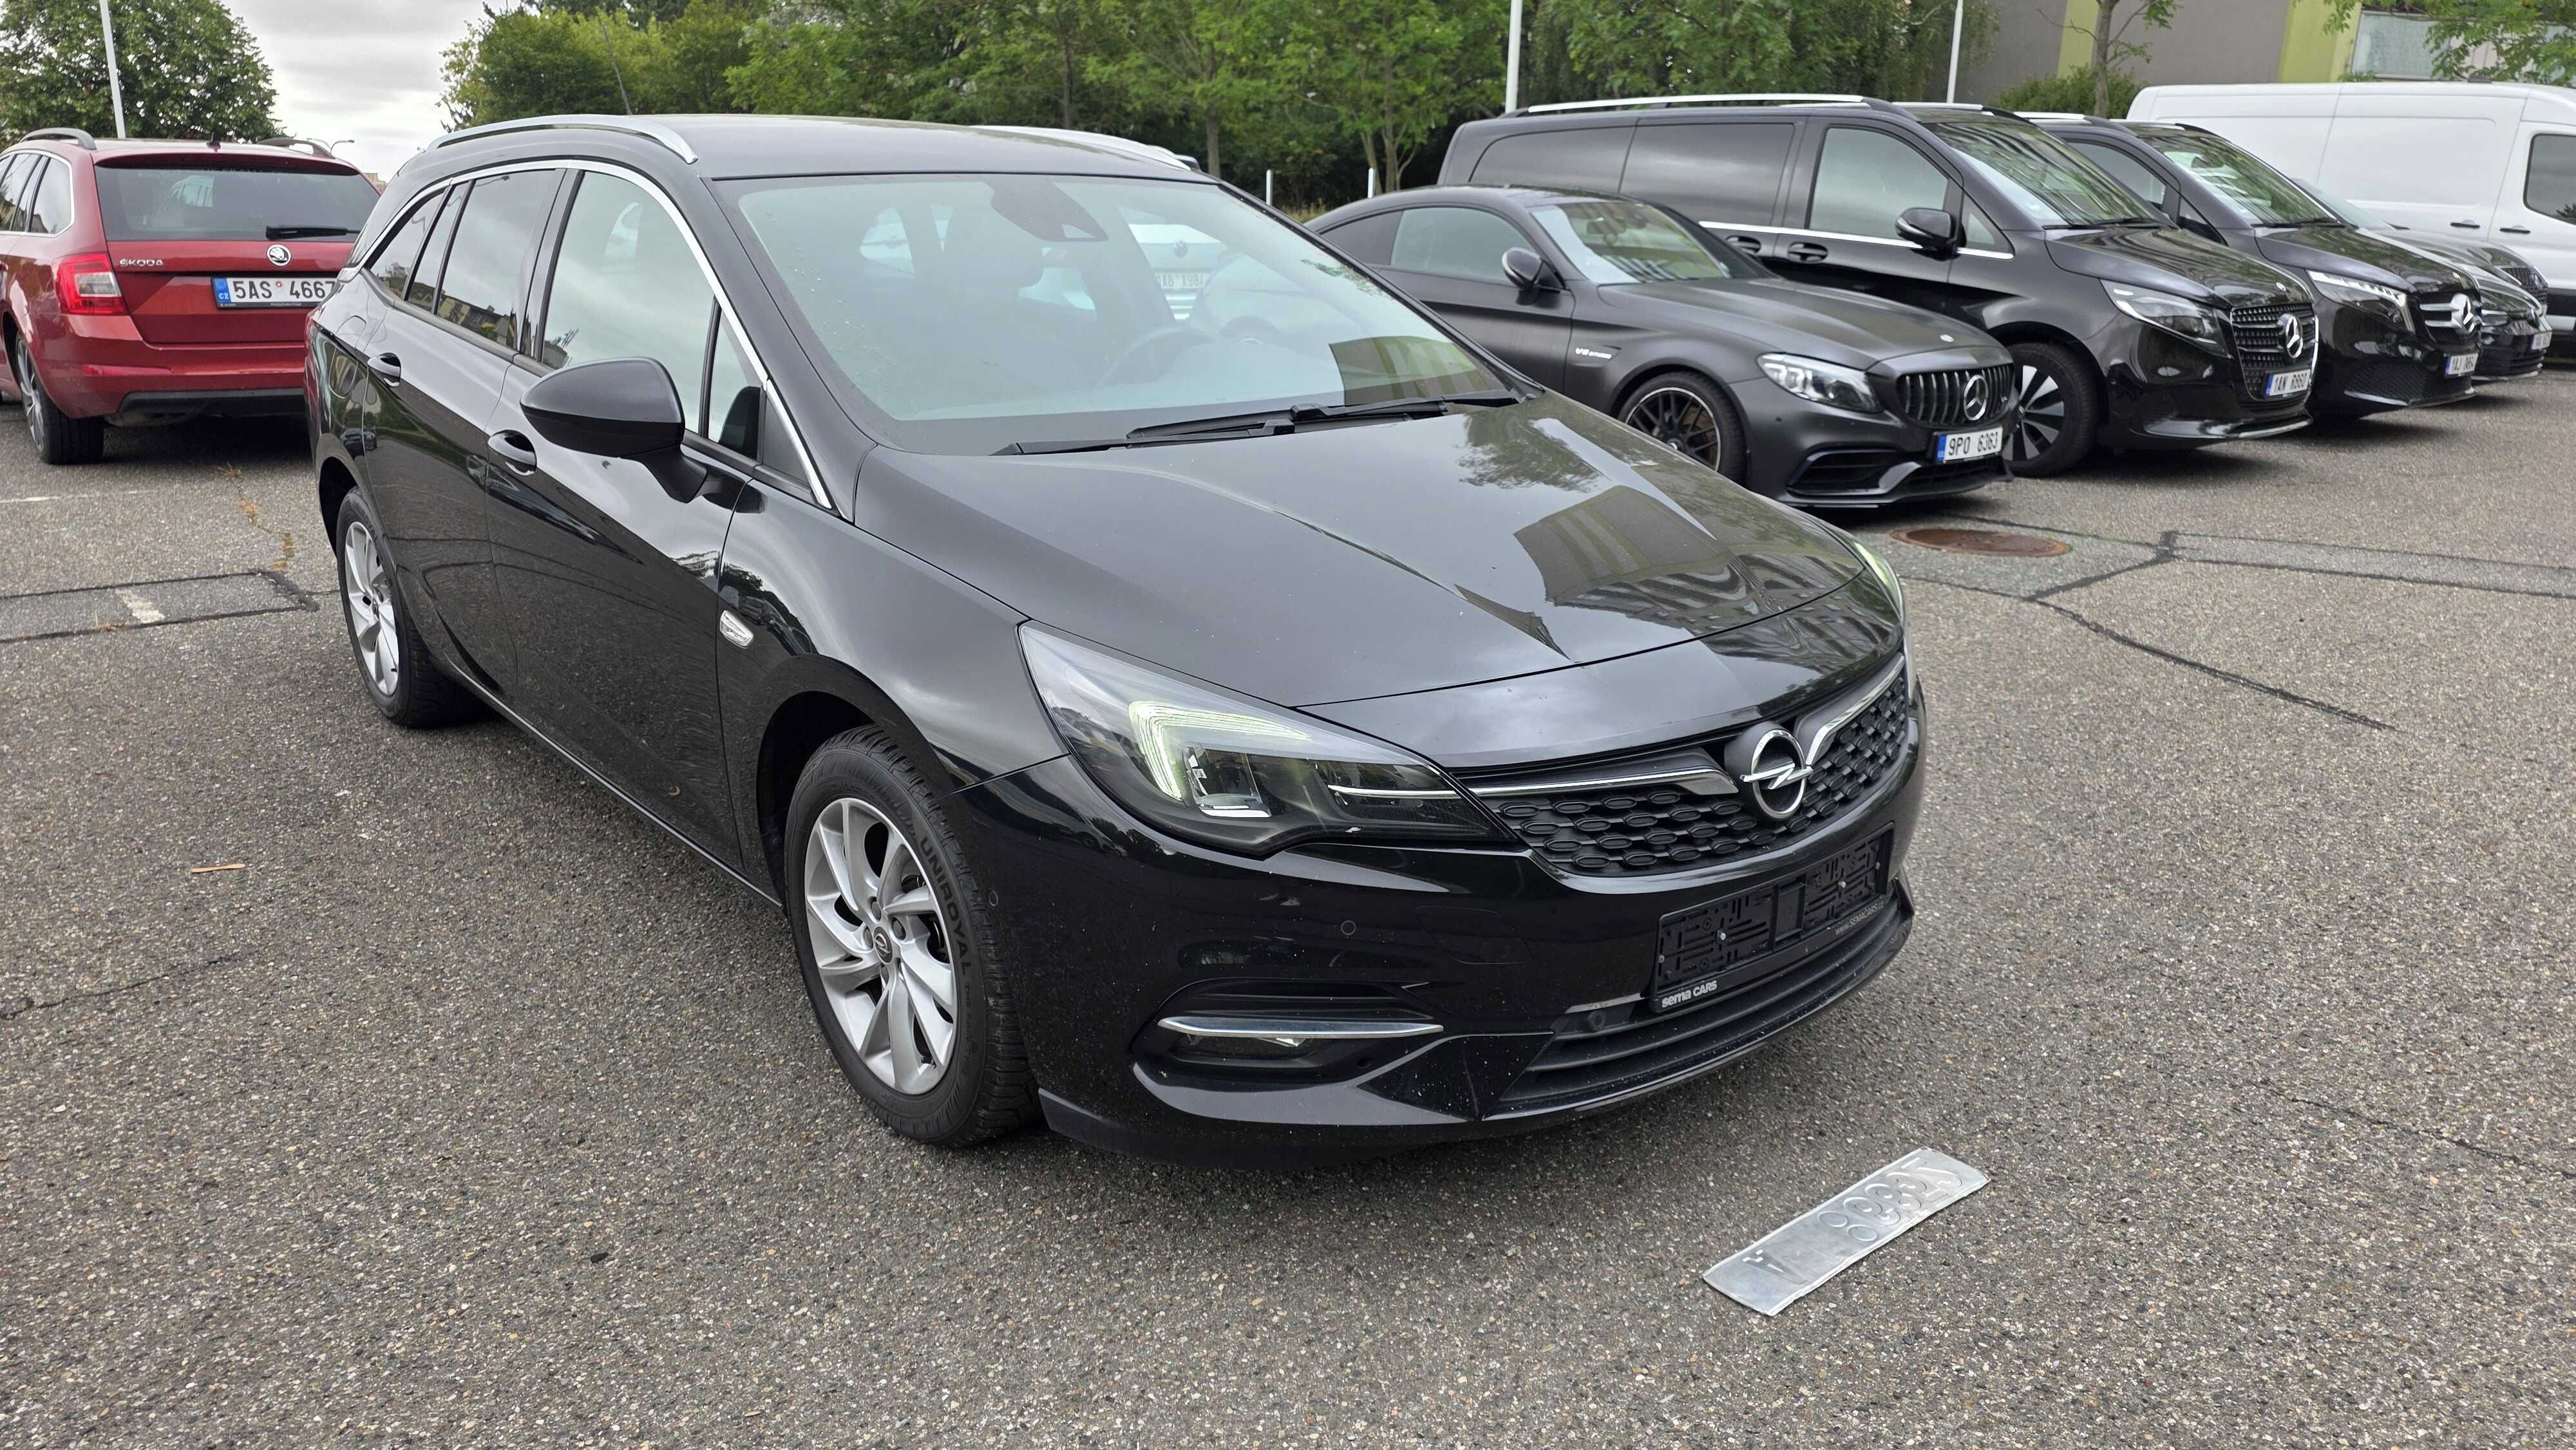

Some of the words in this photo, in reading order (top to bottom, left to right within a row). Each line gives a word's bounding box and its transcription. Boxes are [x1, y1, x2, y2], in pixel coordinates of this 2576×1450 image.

[232, 281, 272, 299] 5AS
[920, 836, 971, 975] UNIROYAL
[1662, 989, 1692, 1009] sema
[1692, 980, 1718, 997] CARS
